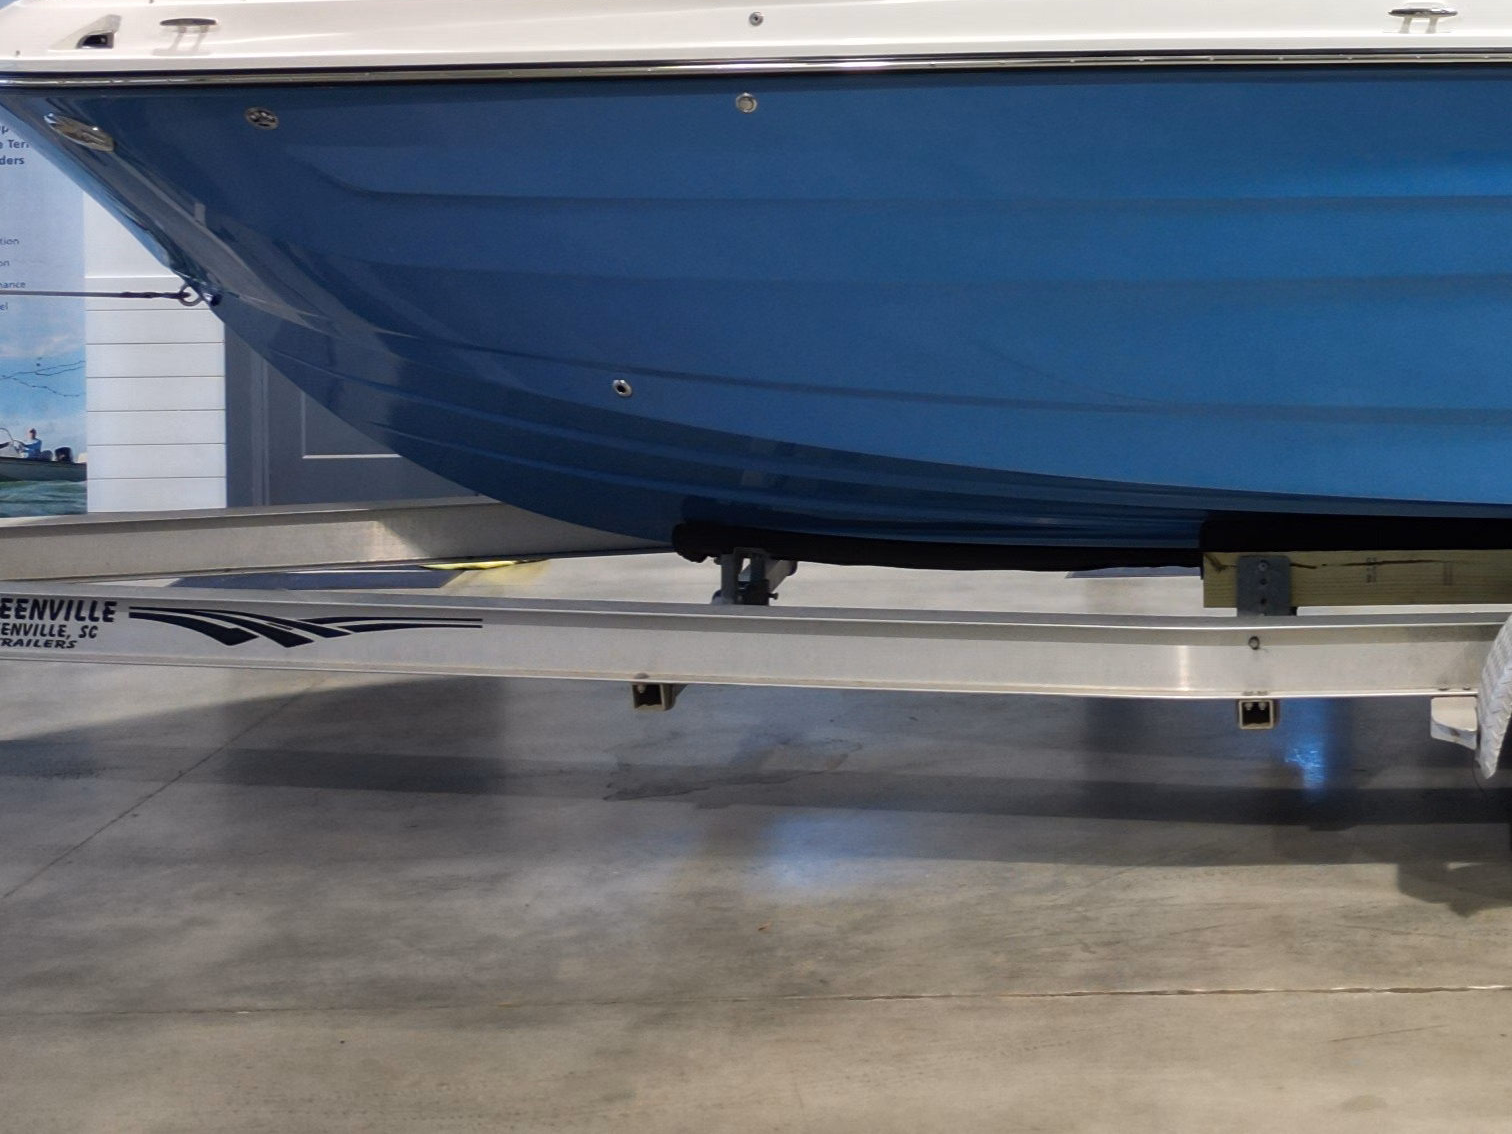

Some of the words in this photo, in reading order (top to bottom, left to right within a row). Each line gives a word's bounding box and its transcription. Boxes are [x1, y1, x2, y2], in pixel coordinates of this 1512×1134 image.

[0, 598, 118, 623] EENVILLE
[78, 624, 99, 639] SC
[0, 637, 78, 650] RAILERS
